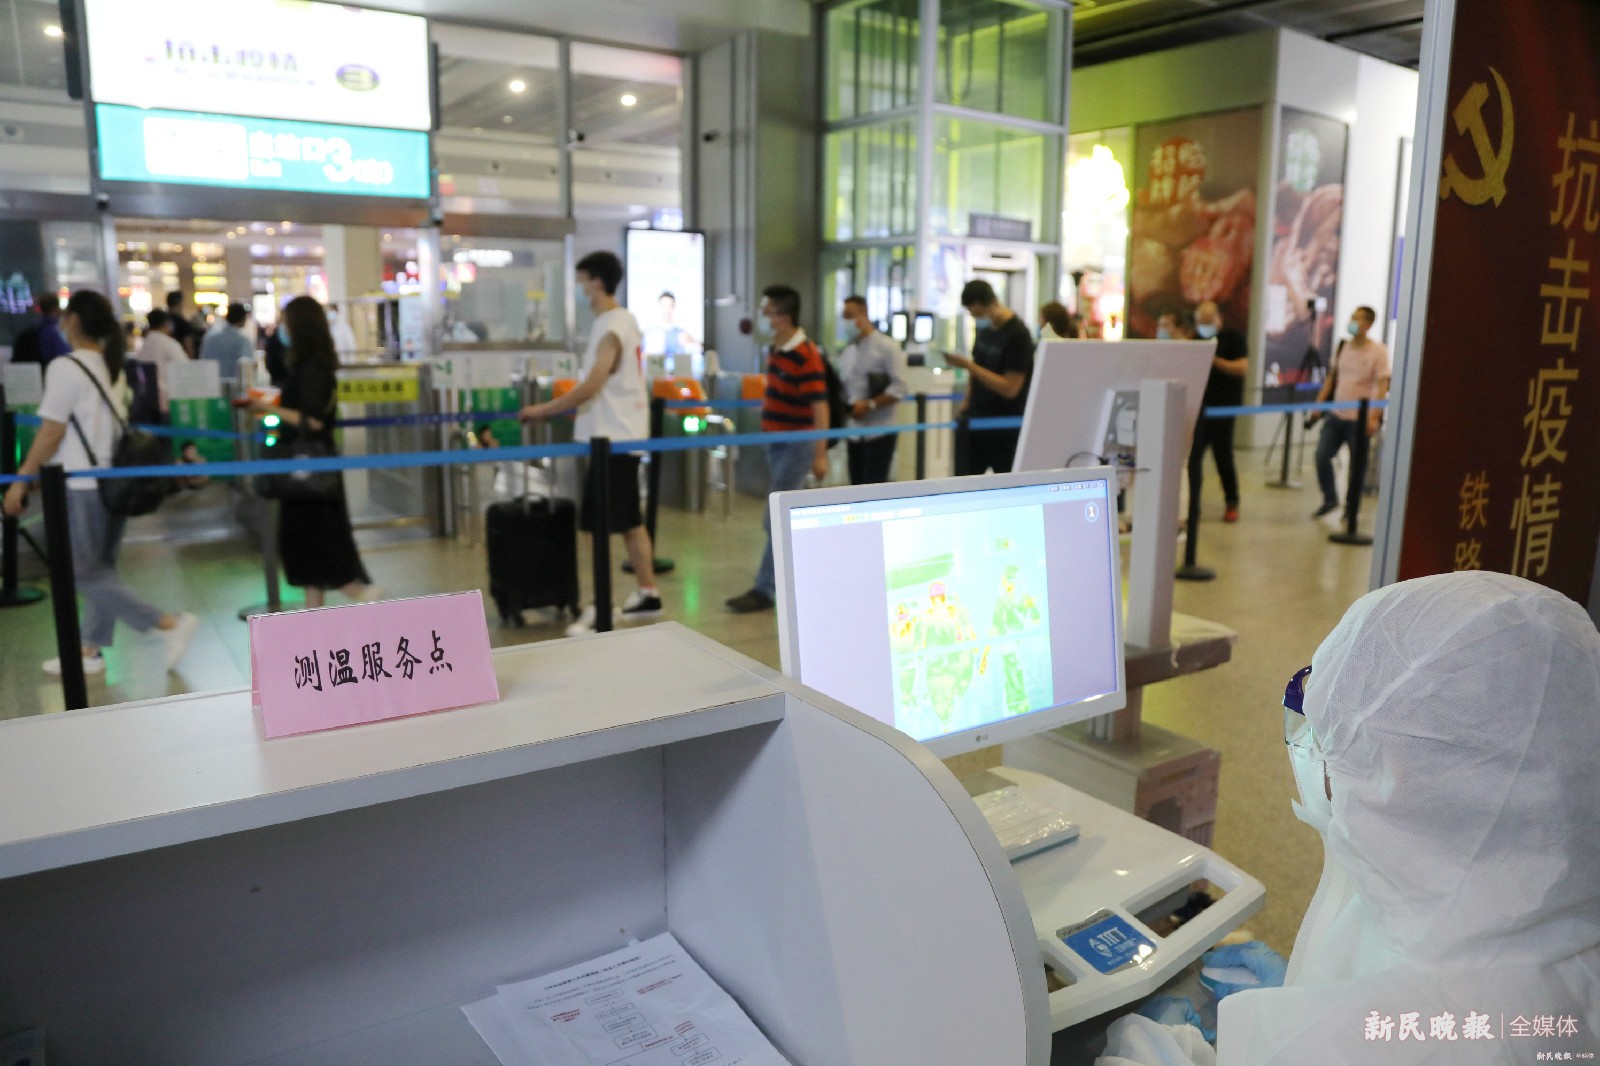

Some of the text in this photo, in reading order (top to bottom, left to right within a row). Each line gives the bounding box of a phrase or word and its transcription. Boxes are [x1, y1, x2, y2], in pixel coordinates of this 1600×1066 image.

[1510, 112, 1600, 577] 抗击疫情
[1453, 470, 1490, 570] 铁路
[294, 630, 453, 692] 测温服务点
